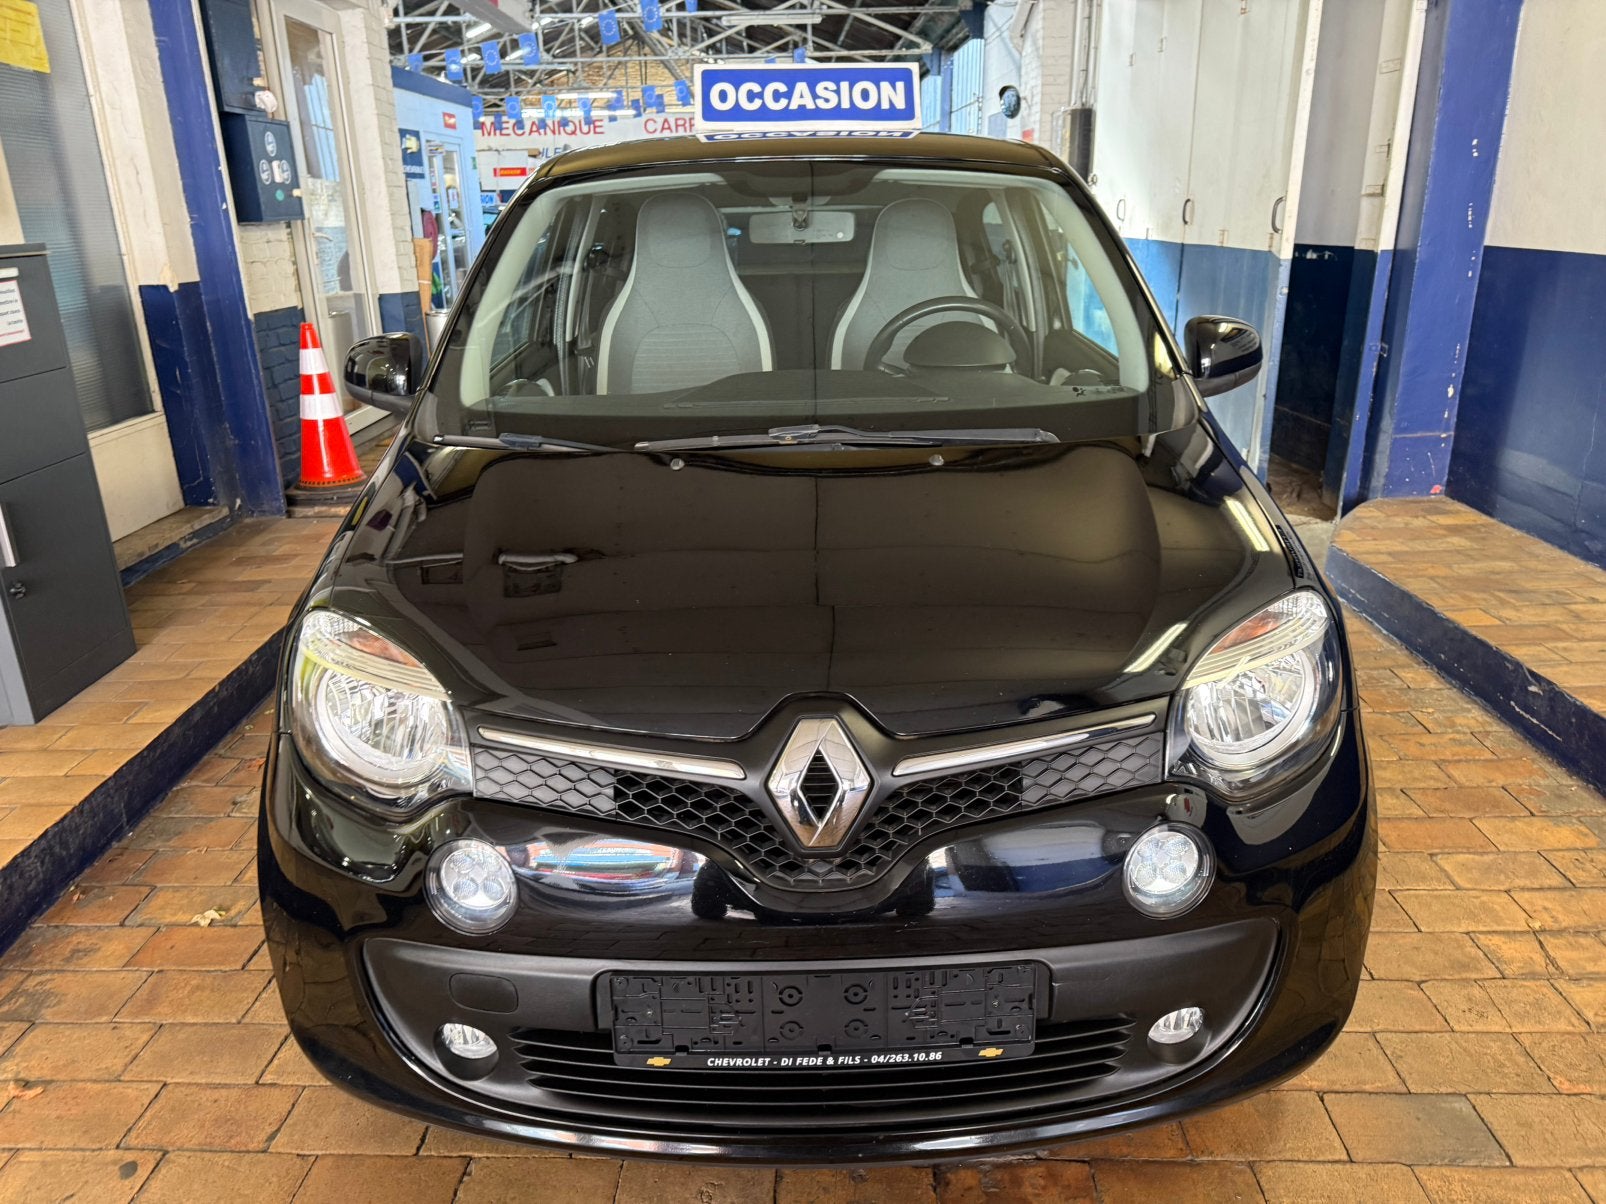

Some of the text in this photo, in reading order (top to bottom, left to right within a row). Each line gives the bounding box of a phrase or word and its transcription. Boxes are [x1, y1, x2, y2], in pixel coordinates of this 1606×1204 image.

[709, 80, 906, 111] OCCASION
[481, 119, 604, 137] MECANIQUE
[707, 1057, 771, 1067] CHEVROLET
[781, 1057, 793, 1067] DI
[796, 1057, 824, 1066] FEDE
[826, 1056, 835, 1065] &
[838, 1056, 861, 1065] FILS
[871, 1051, 943, 1064] 04/263.10.86
